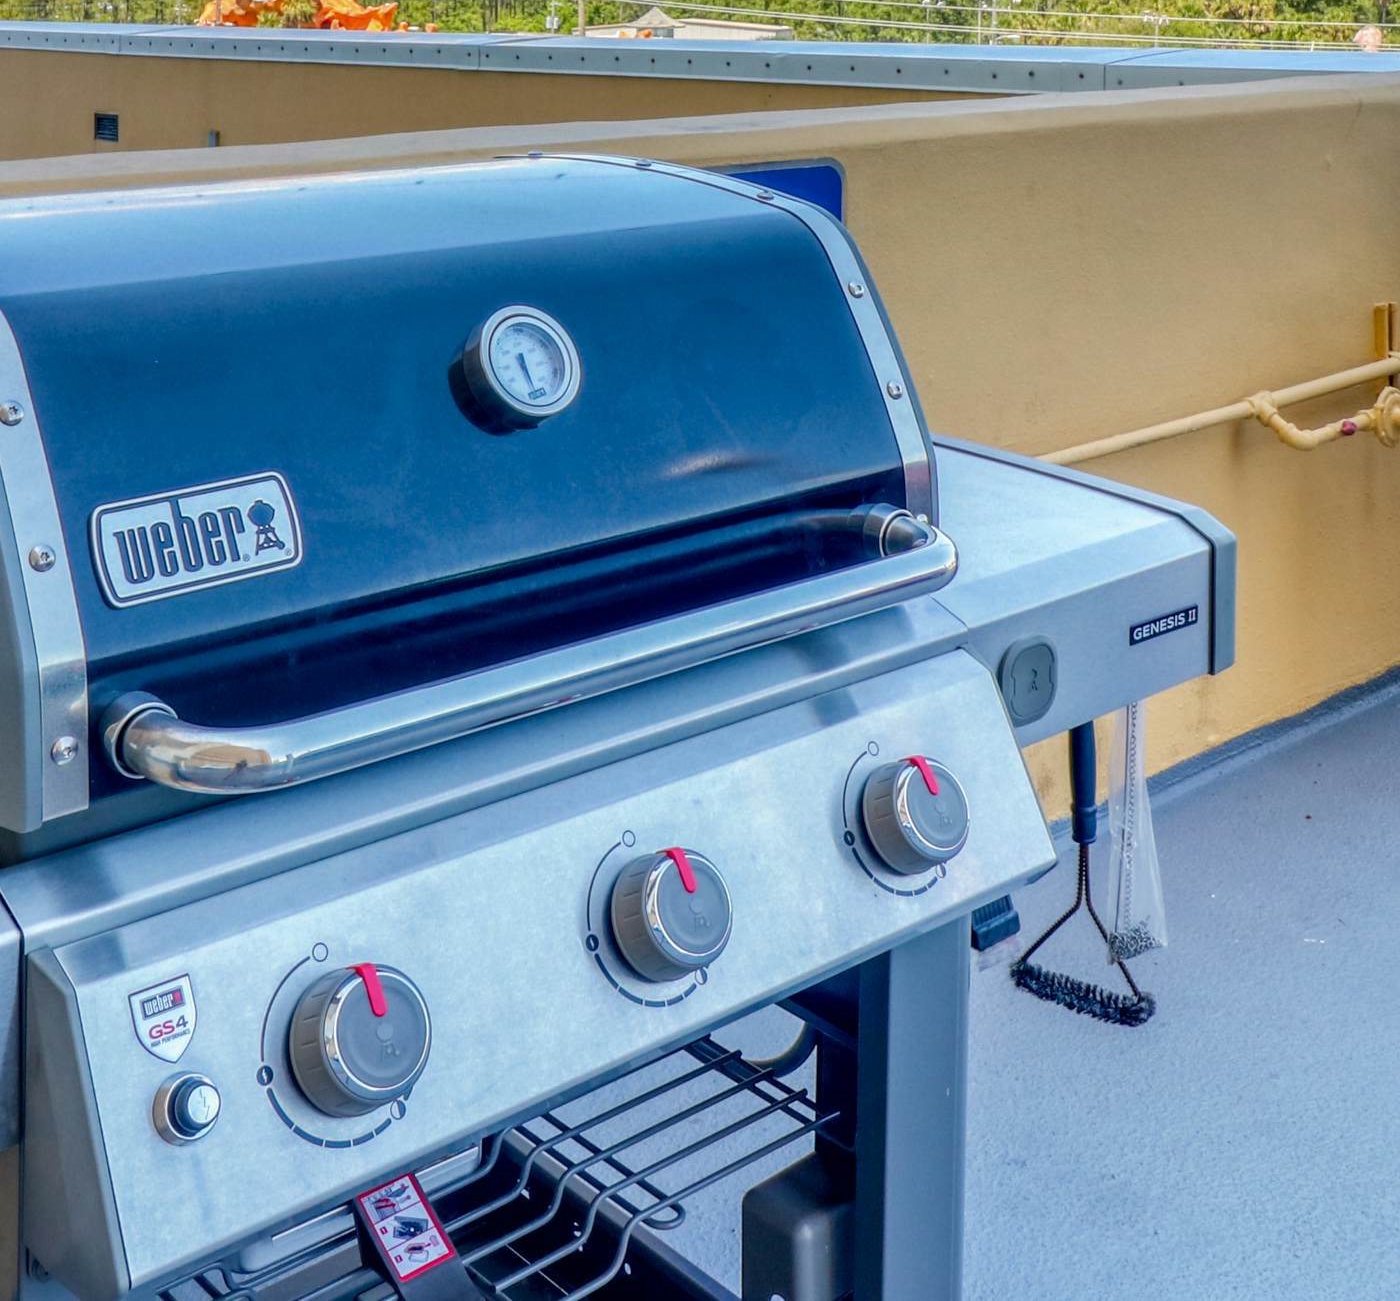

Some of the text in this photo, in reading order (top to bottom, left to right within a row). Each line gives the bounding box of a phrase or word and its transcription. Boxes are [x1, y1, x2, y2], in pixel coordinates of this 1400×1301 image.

[112, 499, 246, 584] weber
[1132, 608, 1197, 641] GENESIS II
[143, 993, 174, 1016] weber
[148, 1014, 189, 1040] GS4
